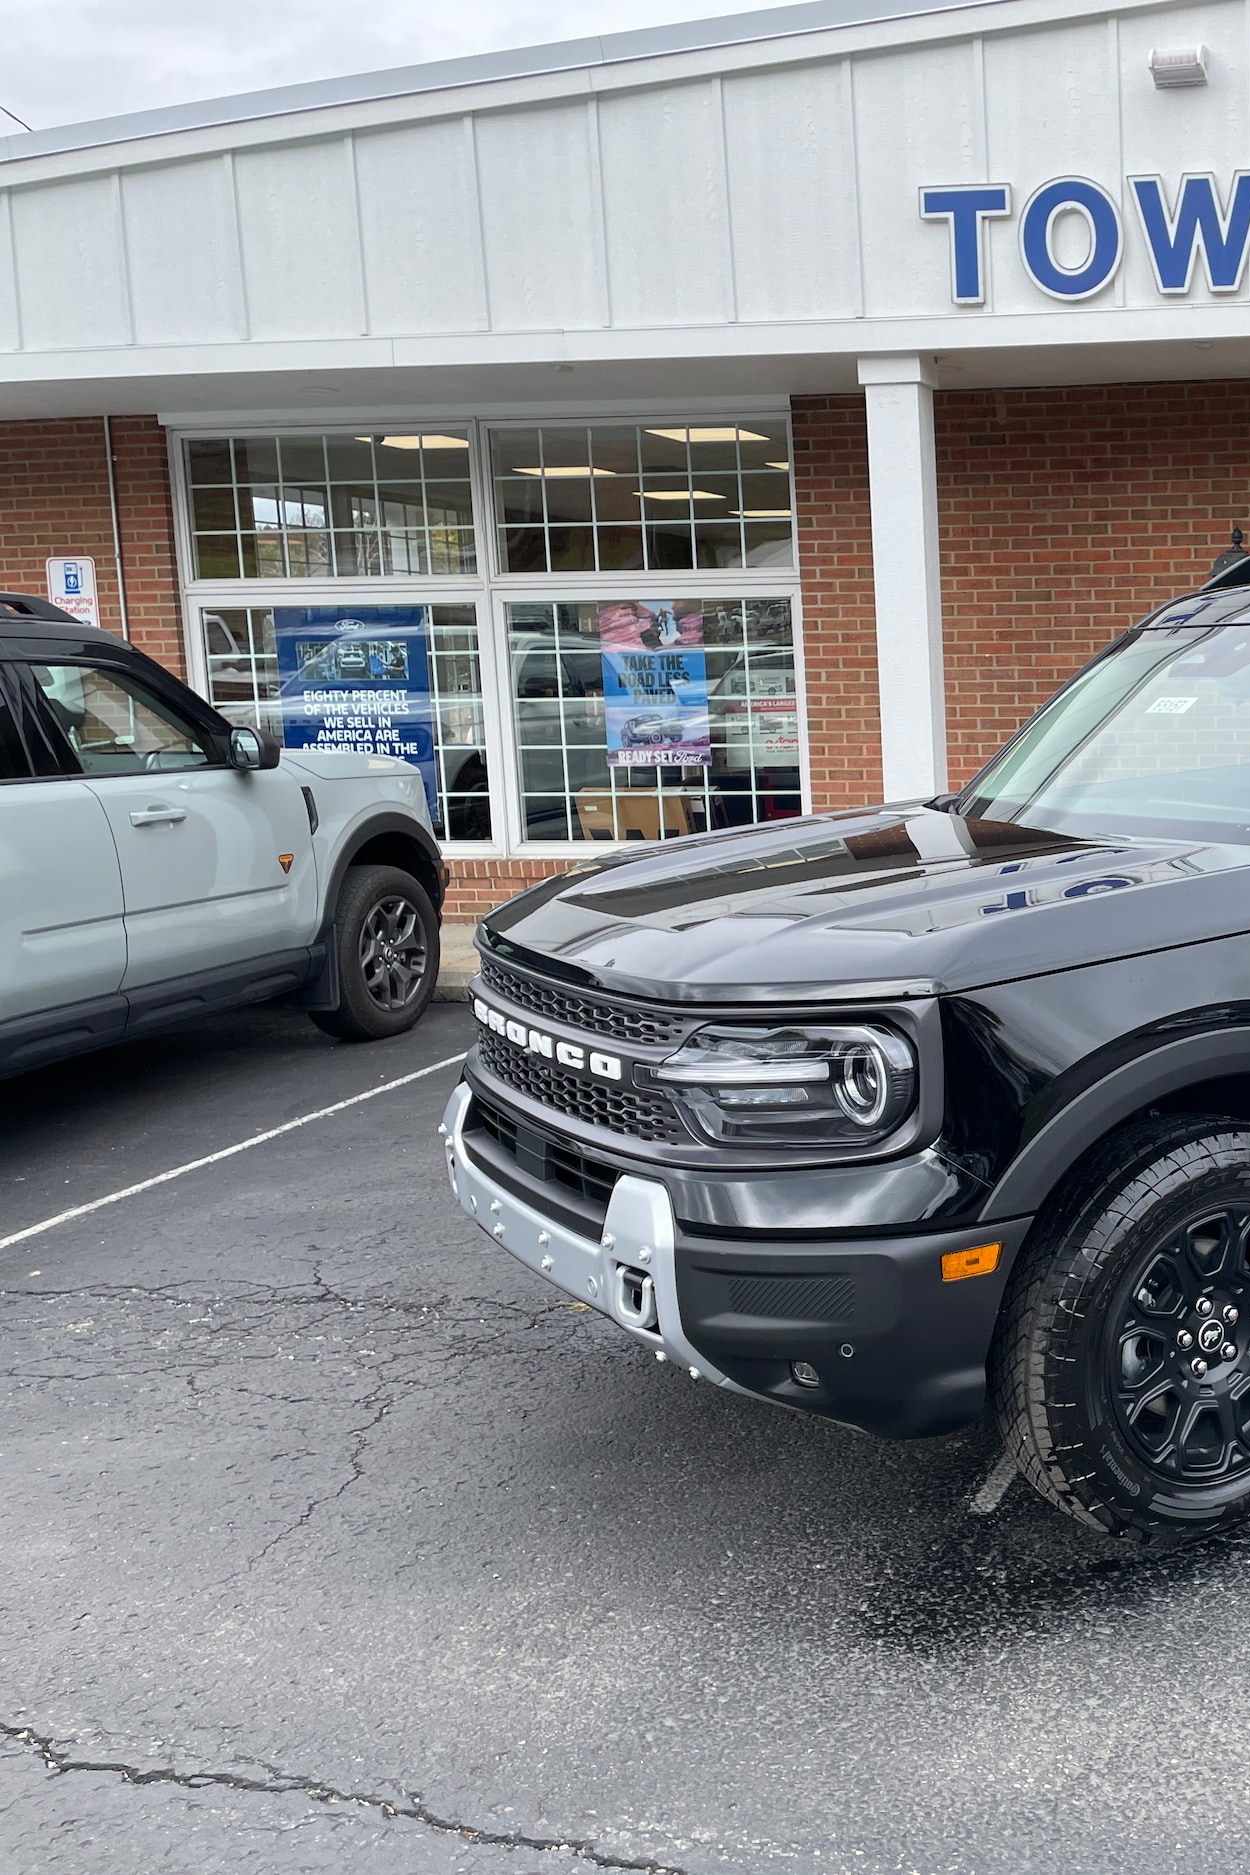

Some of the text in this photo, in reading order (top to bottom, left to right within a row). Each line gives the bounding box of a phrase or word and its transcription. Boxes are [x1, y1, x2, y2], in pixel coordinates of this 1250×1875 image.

[54, 596, 93, 606] Charging
[622, 655, 685, 671] TAKE THE
[617, 672, 691, 688] ROAD LESS
[303, 690, 407, 702] EIGHTY PERCENT
[633, 688, 677, 705] PAVED
[304, 703, 410, 715] OF THE VEHICLES
[324, 717, 391, 728] WE SELL IN
[317, 730, 400, 742] AMERICA ARE
[302, 743, 418, 754] ASSEMBLED IN THE
[618, 750, 703, 763] READY SET Ford
[474, 998, 622, 1081] BRONCO
[1102, 1451, 1140, 1497] Continental
